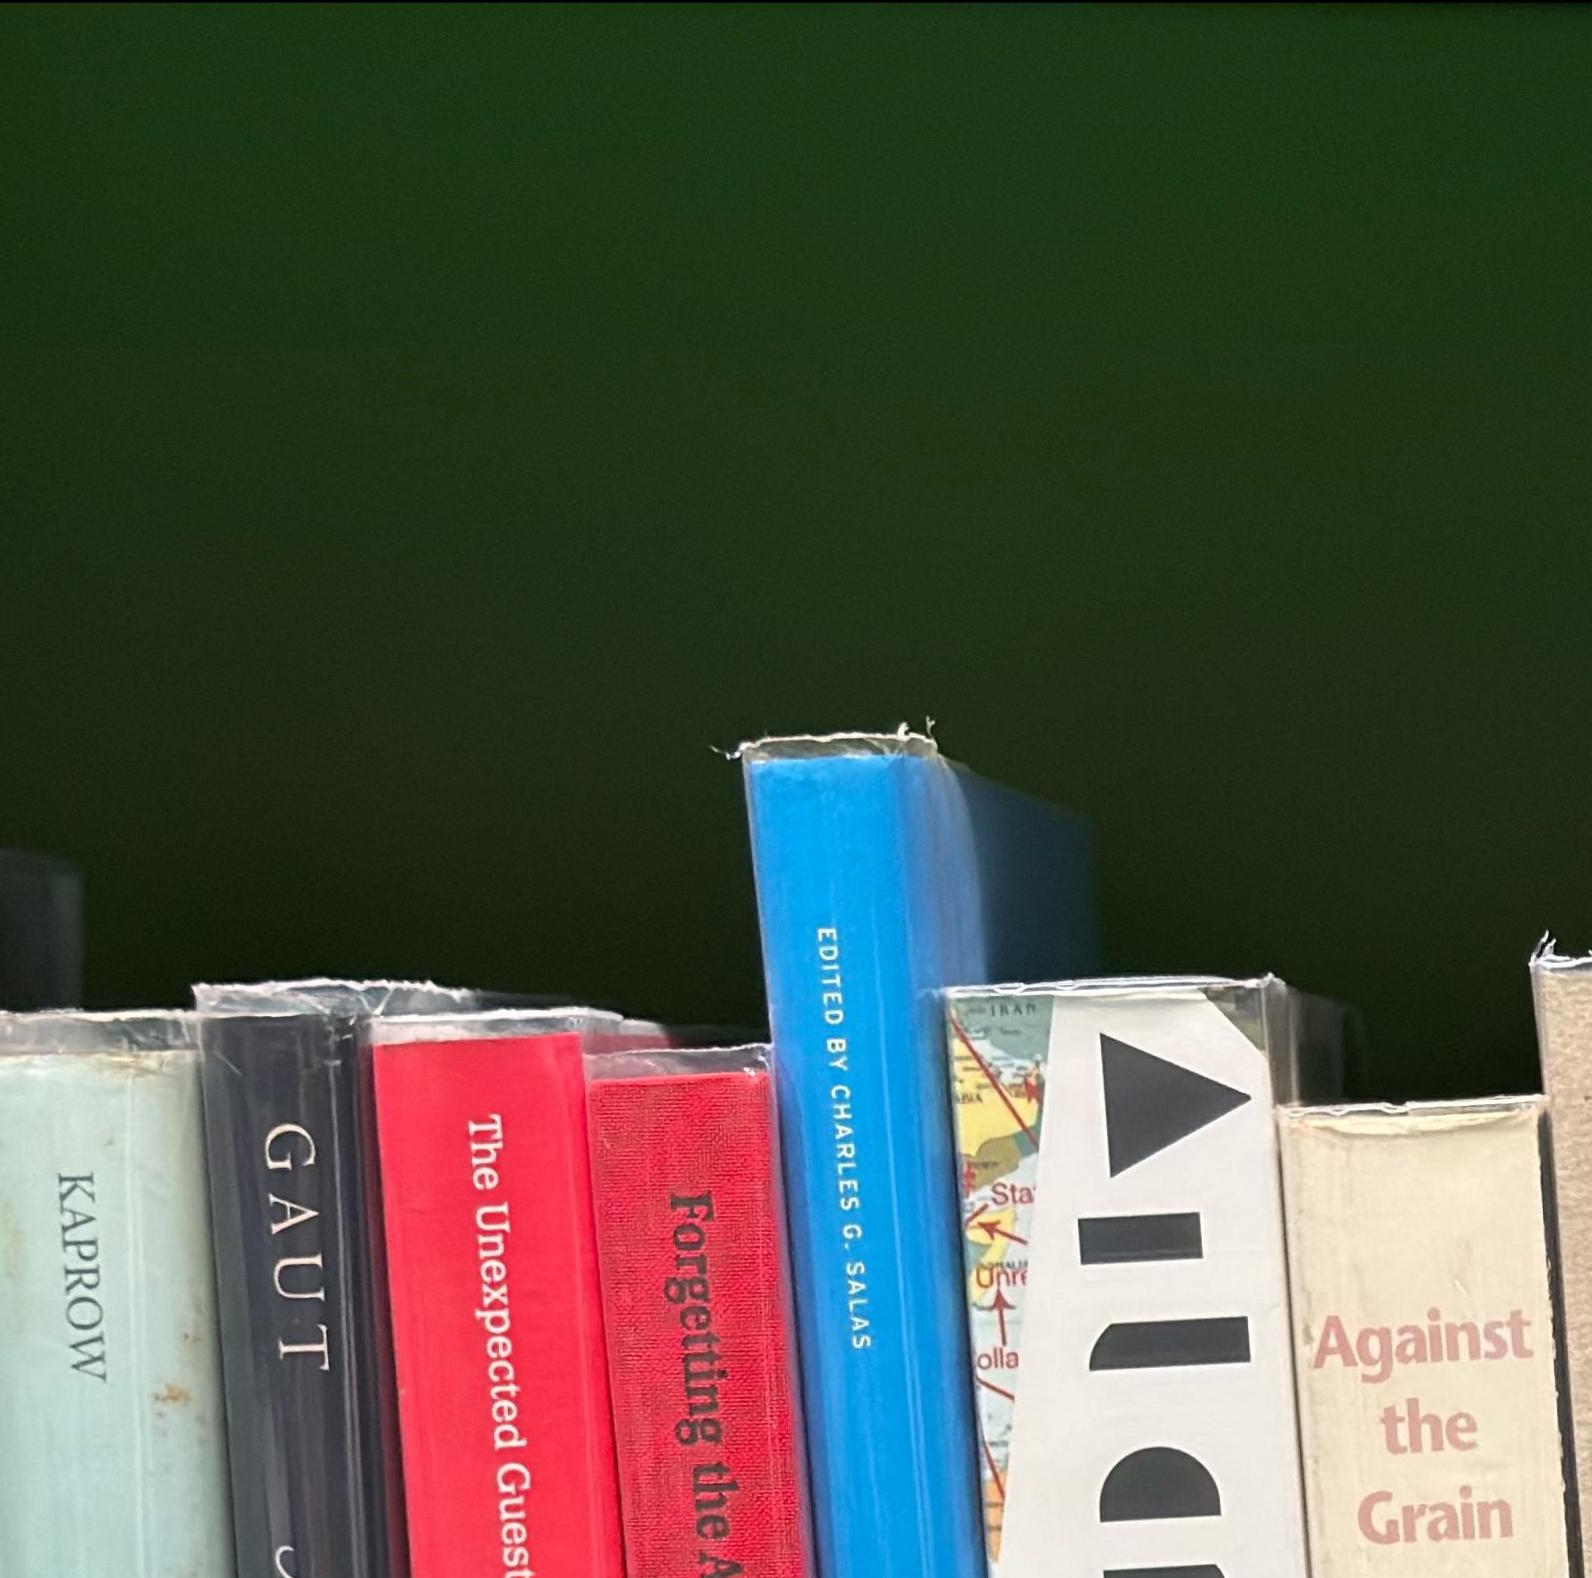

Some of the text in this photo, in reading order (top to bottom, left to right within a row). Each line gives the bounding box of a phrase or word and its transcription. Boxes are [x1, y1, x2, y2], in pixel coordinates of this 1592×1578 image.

[815, 926, 840, 1029] EDITED
[825, 1037, 845, 1074] BY
[466, 1113, 502, 1191] The
[830, 1084, 857, 1213] CHARLES
[56, 1172, 108, 1385] KAPROW
[264, 1122, 330, 1372] GAUT
[473, 1202, 527, 1451] Unexpected
[846, 1259, 871, 1351] SALAS
[1312, 1307, 1535, 1384] Against
[1381, 1401, 1478, 1452] the
[1357, 1489, 1514, 1545] Grain
